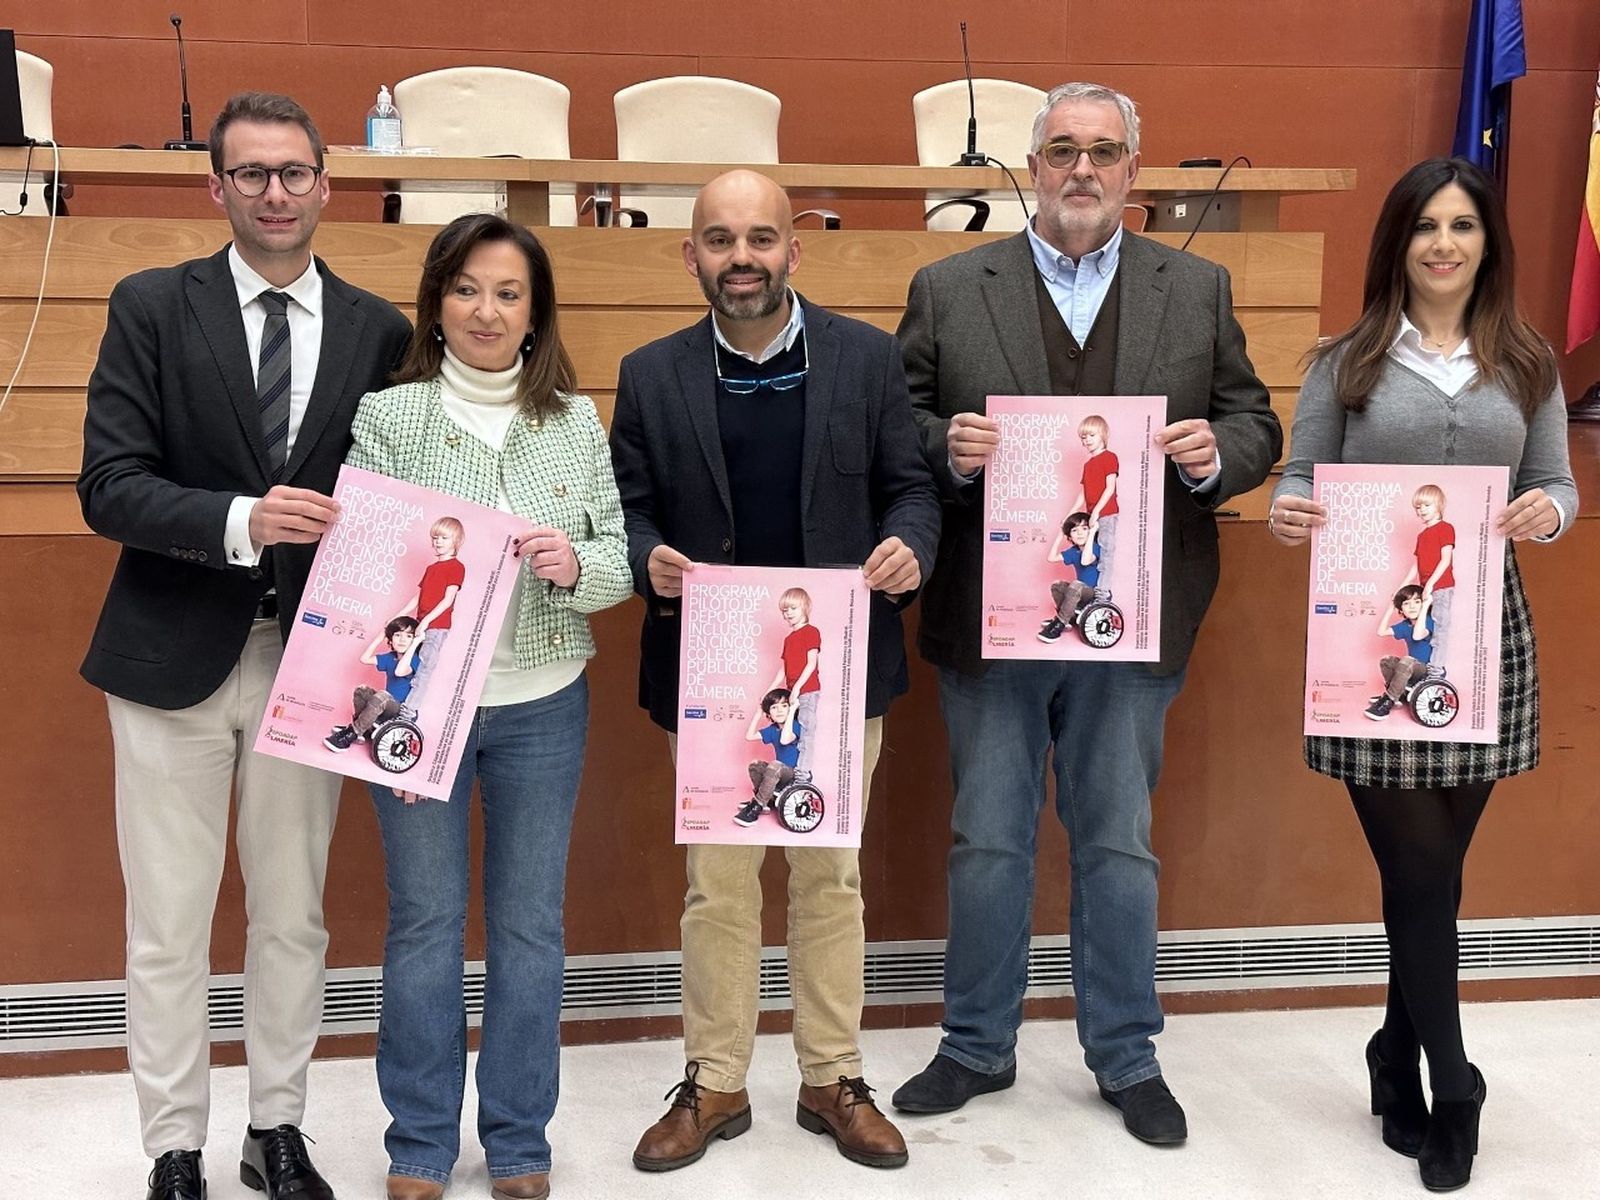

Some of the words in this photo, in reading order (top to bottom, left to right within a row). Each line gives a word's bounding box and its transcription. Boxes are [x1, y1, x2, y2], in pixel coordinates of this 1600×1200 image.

[992, 413, 1070, 427] PROGRAMA
[998, 425, 1040, 439] ILOTO
[1043, 426, 1062, 439] DE
[997, 438, 1056, 452] EPORTE
[992, 450, 1062, 463] INCLUSIVO
[992, 462, 1010, 475] EN
[1012, 462, 1054, 475] CINCO
[991, 474, 1058, 488] COLEGIOS
[1320, 481, 1403, 496] PROGRAMA
[341, 484, 425, 521] PROGRAMA
[991, 498, 1008, 510] DE
[1320, 495, 1371, 508] PILOTO
[1375, 495, 1395, 509] DE
[393, 513, 413, 532] DE
[331, 522, 408, 557] INCLUSIVO
[1319, 532, 1338, 545] EN
[1341, 532, 1386, 546] CINCO
[326, 535, 349, 554] EN
[349, 542, 395, 567] CINCO
[1318, 544, 1390, 558] COLEGIOS
[322, 549, 397, 583] COLEGIOS
[1317, 569, 1336, 582] DE
[313, 575, 337, 593] DE
[689, 583, 770, 598] PROGRAMA
[689, 597, 740, 611] PILOTO
[743, 598, 761, 611] DE
[688, 610, 755, 624] DEPORTE
[688, 622, 762, 637] INCLUSIVO
[688, 635, 706, 648] EN
[709, 636, 754, 649] CINCO
[687, 648, 758, 662] COLEGIOS
[686, 673, 705, 686] DE
